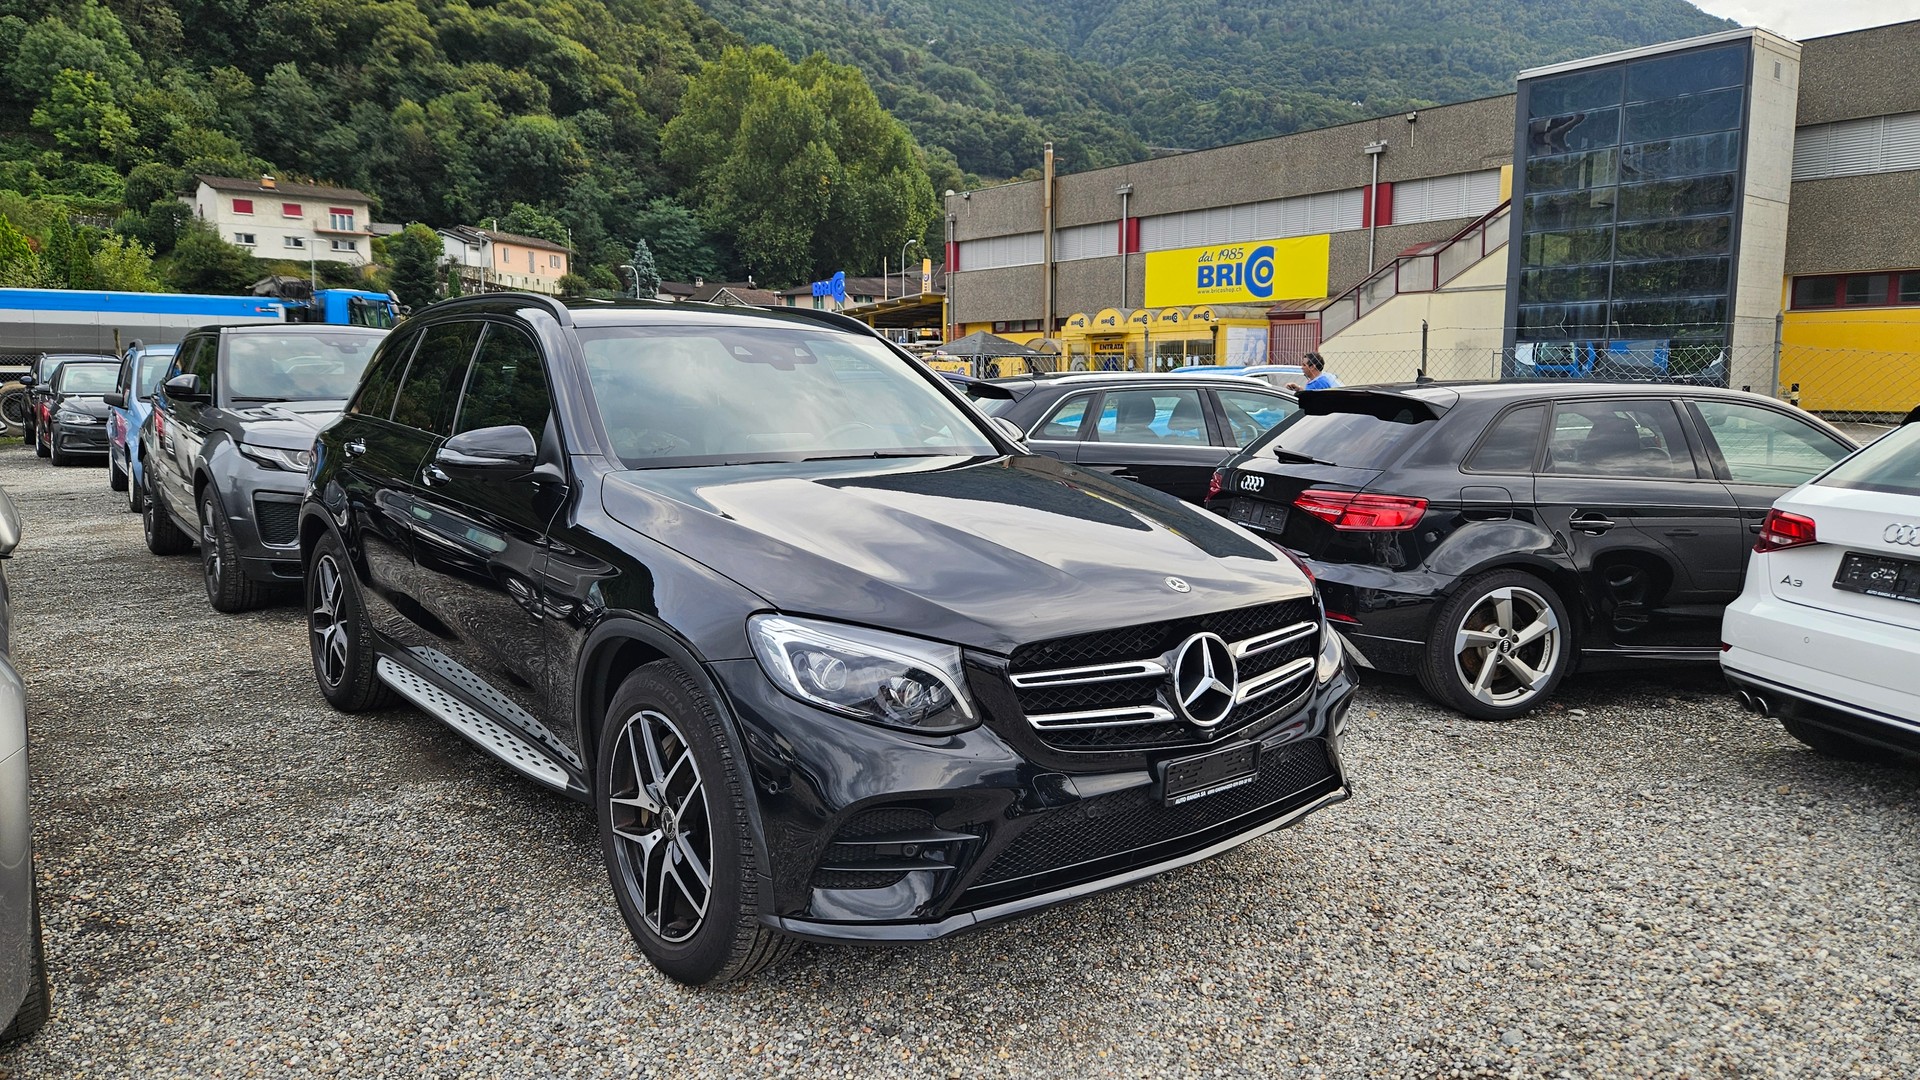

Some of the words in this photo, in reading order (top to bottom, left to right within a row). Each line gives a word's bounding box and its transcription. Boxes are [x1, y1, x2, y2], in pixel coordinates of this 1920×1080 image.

[1198, 251, 1214, 262] dal
[1218, 248, 1244, 261] 1985
[1197, 246, 1274, 298] BRICO
[812, 271, 846, 303] BRICO
[1099, 343, 1124, 351] ENTRATA
[1780, 575, 1803, 588] A3
